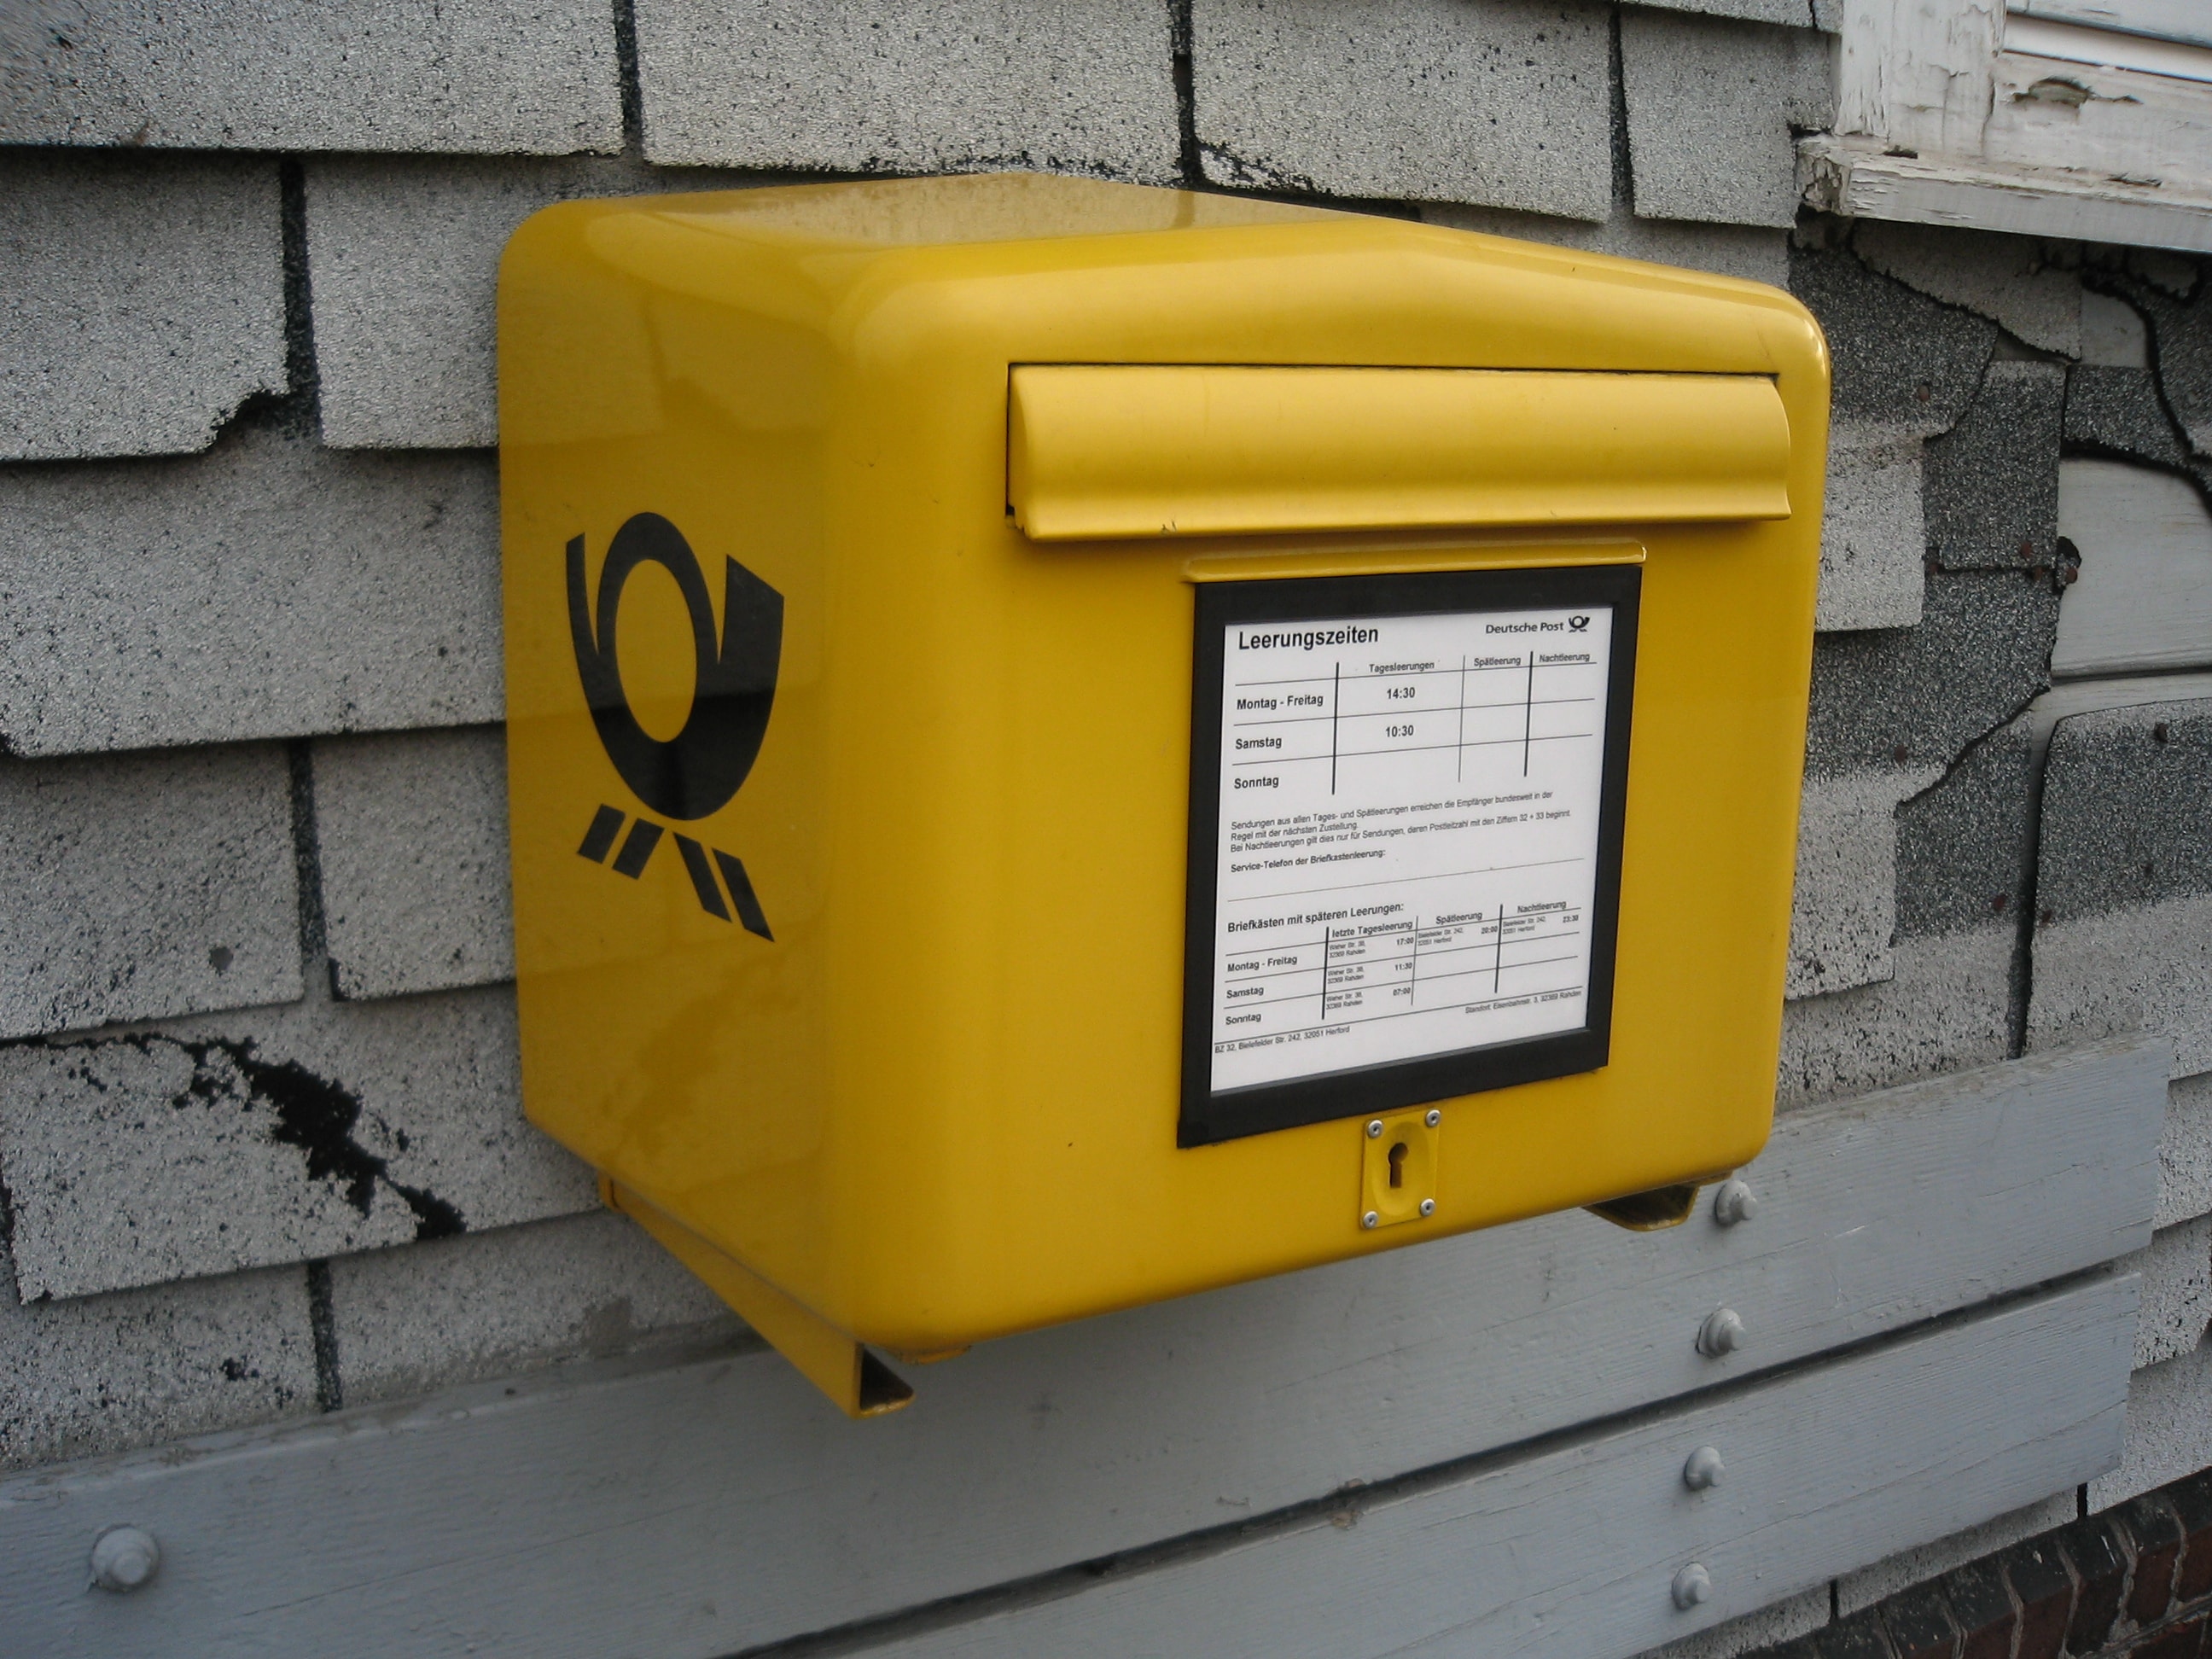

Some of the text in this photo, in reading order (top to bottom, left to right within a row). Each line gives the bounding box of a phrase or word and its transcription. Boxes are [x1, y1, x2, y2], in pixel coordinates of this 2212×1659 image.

[1486, 621, 1563, 634] Deutsche Post
[1239, 626, 1379, 650] Leerungszeiten
[1474, 656, 1521, 667] Spätleerung
[1540, 653, 1590, 662] Nachtleerung
[1369, 661, 1435, 673] Tagesleerungen
[1387, 687, 1416, 700] 14:30
[1237, 698, 1278, 711] Montag
[1287, 695, 1324, 707] Freitag
[1385, 725, 1414, 738] 10:30
[1235, 736, 1282, 749] Samstag
[1234, 777, 1279, 789] Sonntag
[1231, 818, 1275, 830] Sendungen
[1293, 815, 1310, 824] allen
[1313, 813, 1338, 823] Tages-
[1341, 810, 1354, 818] und
[1356, 806, 1409, 818] Spätleerungen
[1411, 803, 1442, 812] erreichen
[1444, 800, 1455, 809] die
[1457, 797, 1493, 807] Empfänger
[1495, 793, 1533, 804] bundesweit
[1542, 790, 1553, 799] der
[1231, 822, 1359, 841] Regel mit der nächsten Zustellung.
[1231, 844, 1243, 853] Bei
[1245, 838, 1305, 851] Nachtleerungen
[1306, 836, 1317, 846] gilt
[1319, 835, 1335, 843] dies
[1350, 831, 1360, 840] für
[1362, 827, 1406, 838] Sendungen,
[1407, 825, 1428, 834] deren
[1429, 820, 1469, 831] Postleitzahl
[1470, 818, 1480, 827] mit
[1481, 818, 1494, 826] den
[1496, 815, 1517, 824] Ziffern
[1231, 849, 1386, 873] Service-Telefon der Briefkastenleerung:
[1517, 900, 1567, 913] Nachtleerung
[1227, 903, 1404, 933] Briefkästen mit späteren Leerungen:
[1436, 911, 1482, 924] Spätleerung
[1332, 921, 1413, 938] letzte Tagesleerung
[1481, 926, 1498, 934] 20:00
[1396, 937, 1414, 946] 17:00
[1227, 961, 1260, 972] Montag
[1267, 955, 1297, 967] Freitag
[1395, 963, 1412, 971] 11:30
[1226, 987, 1264, 998] Samstag
[1225, 1013, 1261, 1025] Sonntag
[1214, 1045, 1225, 1053] BZ
[1304, 1031, 1324, 1039] 32051
[1325, 1026, 1350, 1036] Herford
